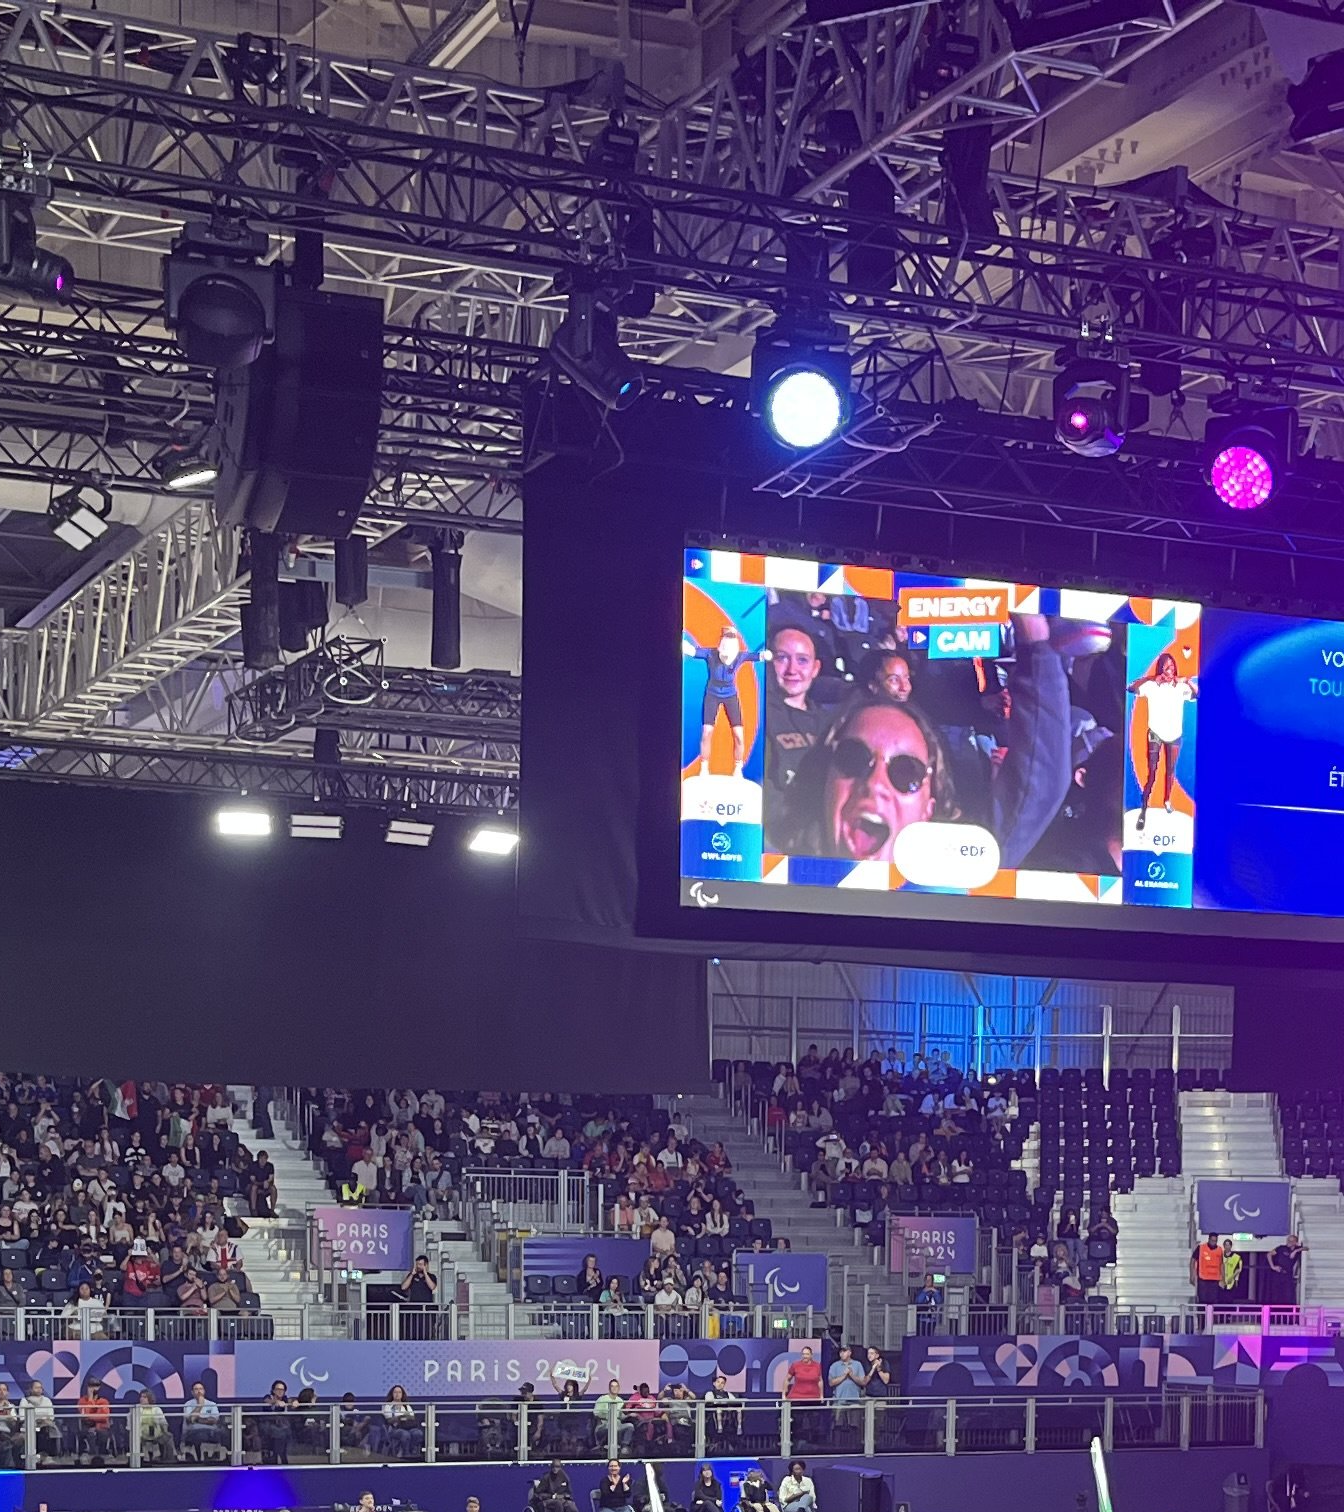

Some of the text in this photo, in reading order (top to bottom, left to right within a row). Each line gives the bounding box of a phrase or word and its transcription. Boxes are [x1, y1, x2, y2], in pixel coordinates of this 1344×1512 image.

[908, 596, 1002, 618] ENERGY
[937, 630, 991, 652] CAM
[336, 1223, 389, 1239] PARIS
[334, 1239, 389, 1256] 2024
[424, 1358, 521, 1383] PARIS
